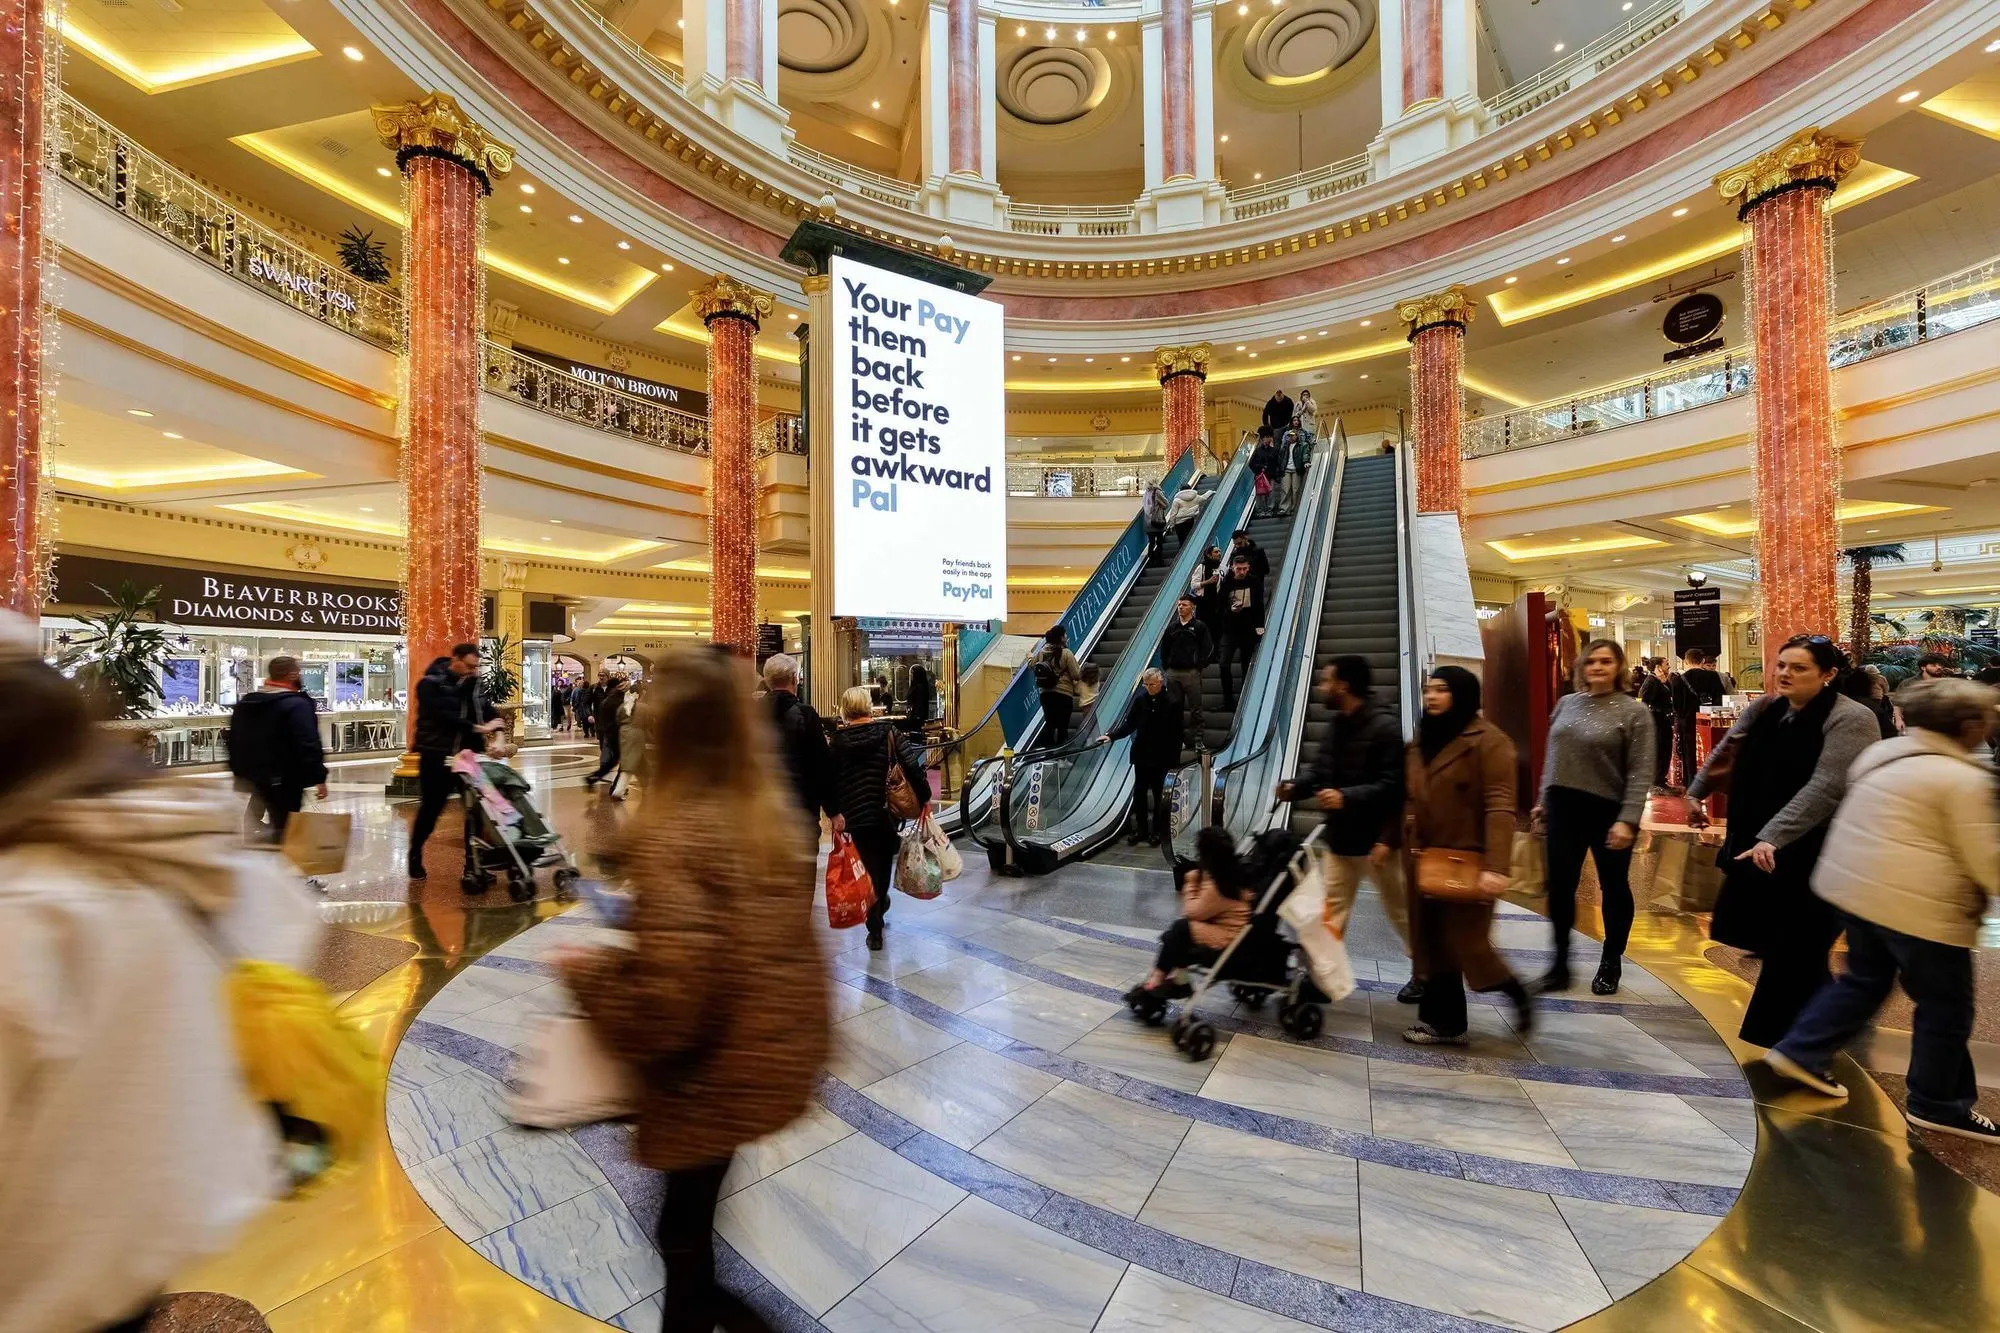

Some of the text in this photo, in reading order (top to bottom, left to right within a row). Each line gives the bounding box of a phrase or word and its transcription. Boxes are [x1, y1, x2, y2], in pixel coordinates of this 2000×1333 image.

[842, 277, 971, 345] Your Pay
[848, 315, 926, 358] them
[852, 345, 925, 389] back
[628, 379, 678, 402] BROWN
[852, 378, 950, 425] before
[852, 413, 941, 457] it gets
[851, 453, 991, 494] awkward
[853, 479, 897, 513] Pal
[304, 551, 311, 560] 4
[942, 558, 992, 569] Pay friends back
[942, 568, 961, 577] easily
[202, 576, 399, 612] BEAVERBROOKS
[942, 581, 993, 602] PayPal
[173, 599, 294, 623] DIAMONDS
[300, 610, 315, 624] &
